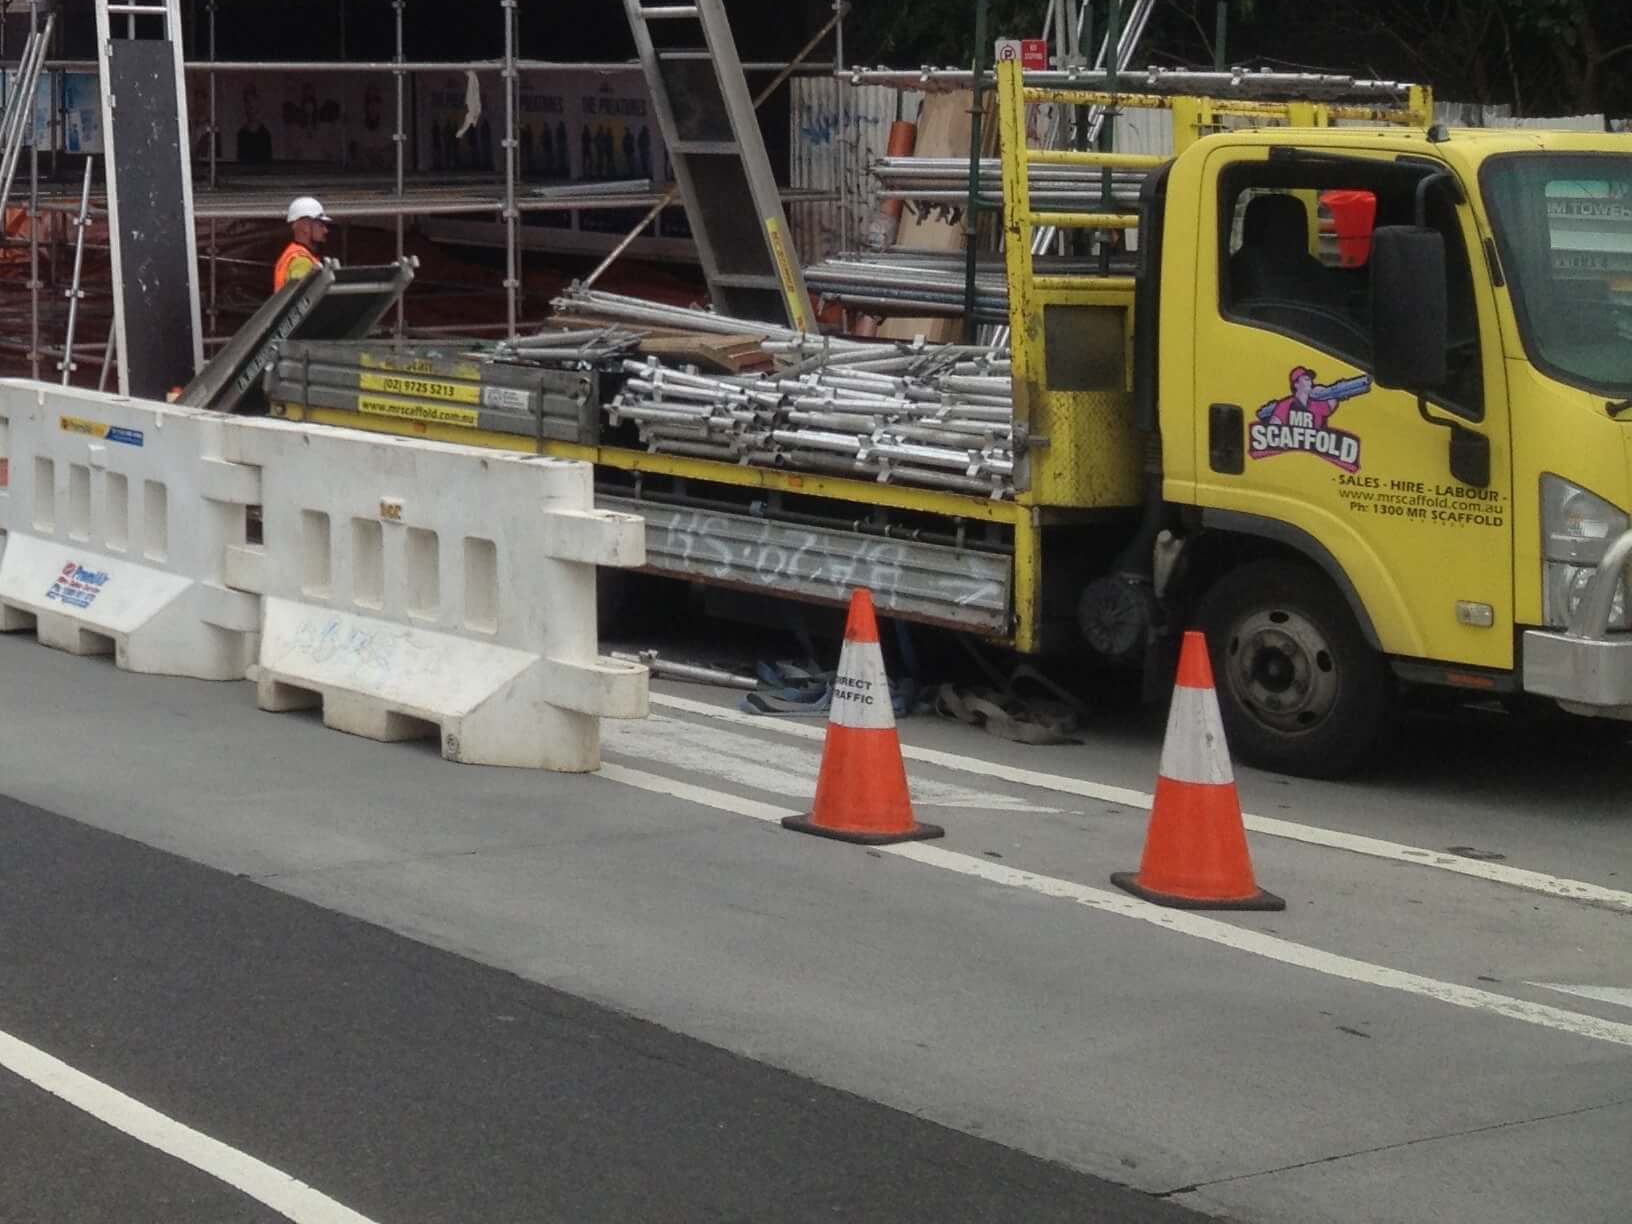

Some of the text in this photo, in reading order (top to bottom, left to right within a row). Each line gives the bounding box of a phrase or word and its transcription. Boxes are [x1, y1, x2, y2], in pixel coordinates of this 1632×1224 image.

[383, 378, 456, 398] (02) 9725 5213
[361, 400, 475, 425] www.mrscaffold.com.au
[1289, 410, 1314, 429] MR
[1251, 424, 1359, 464] SCAFFOLD
[1338, 474, 1500, 503] SALES HIRE LABOUR
[1338, 487, 1504, 514] www.mrscaffold.com.au
[1373, 503, 1404, 517] 1300
[1406, 507, 1427, 519] MR
[1431, 509, 1504, 528] SCAFFOLD
